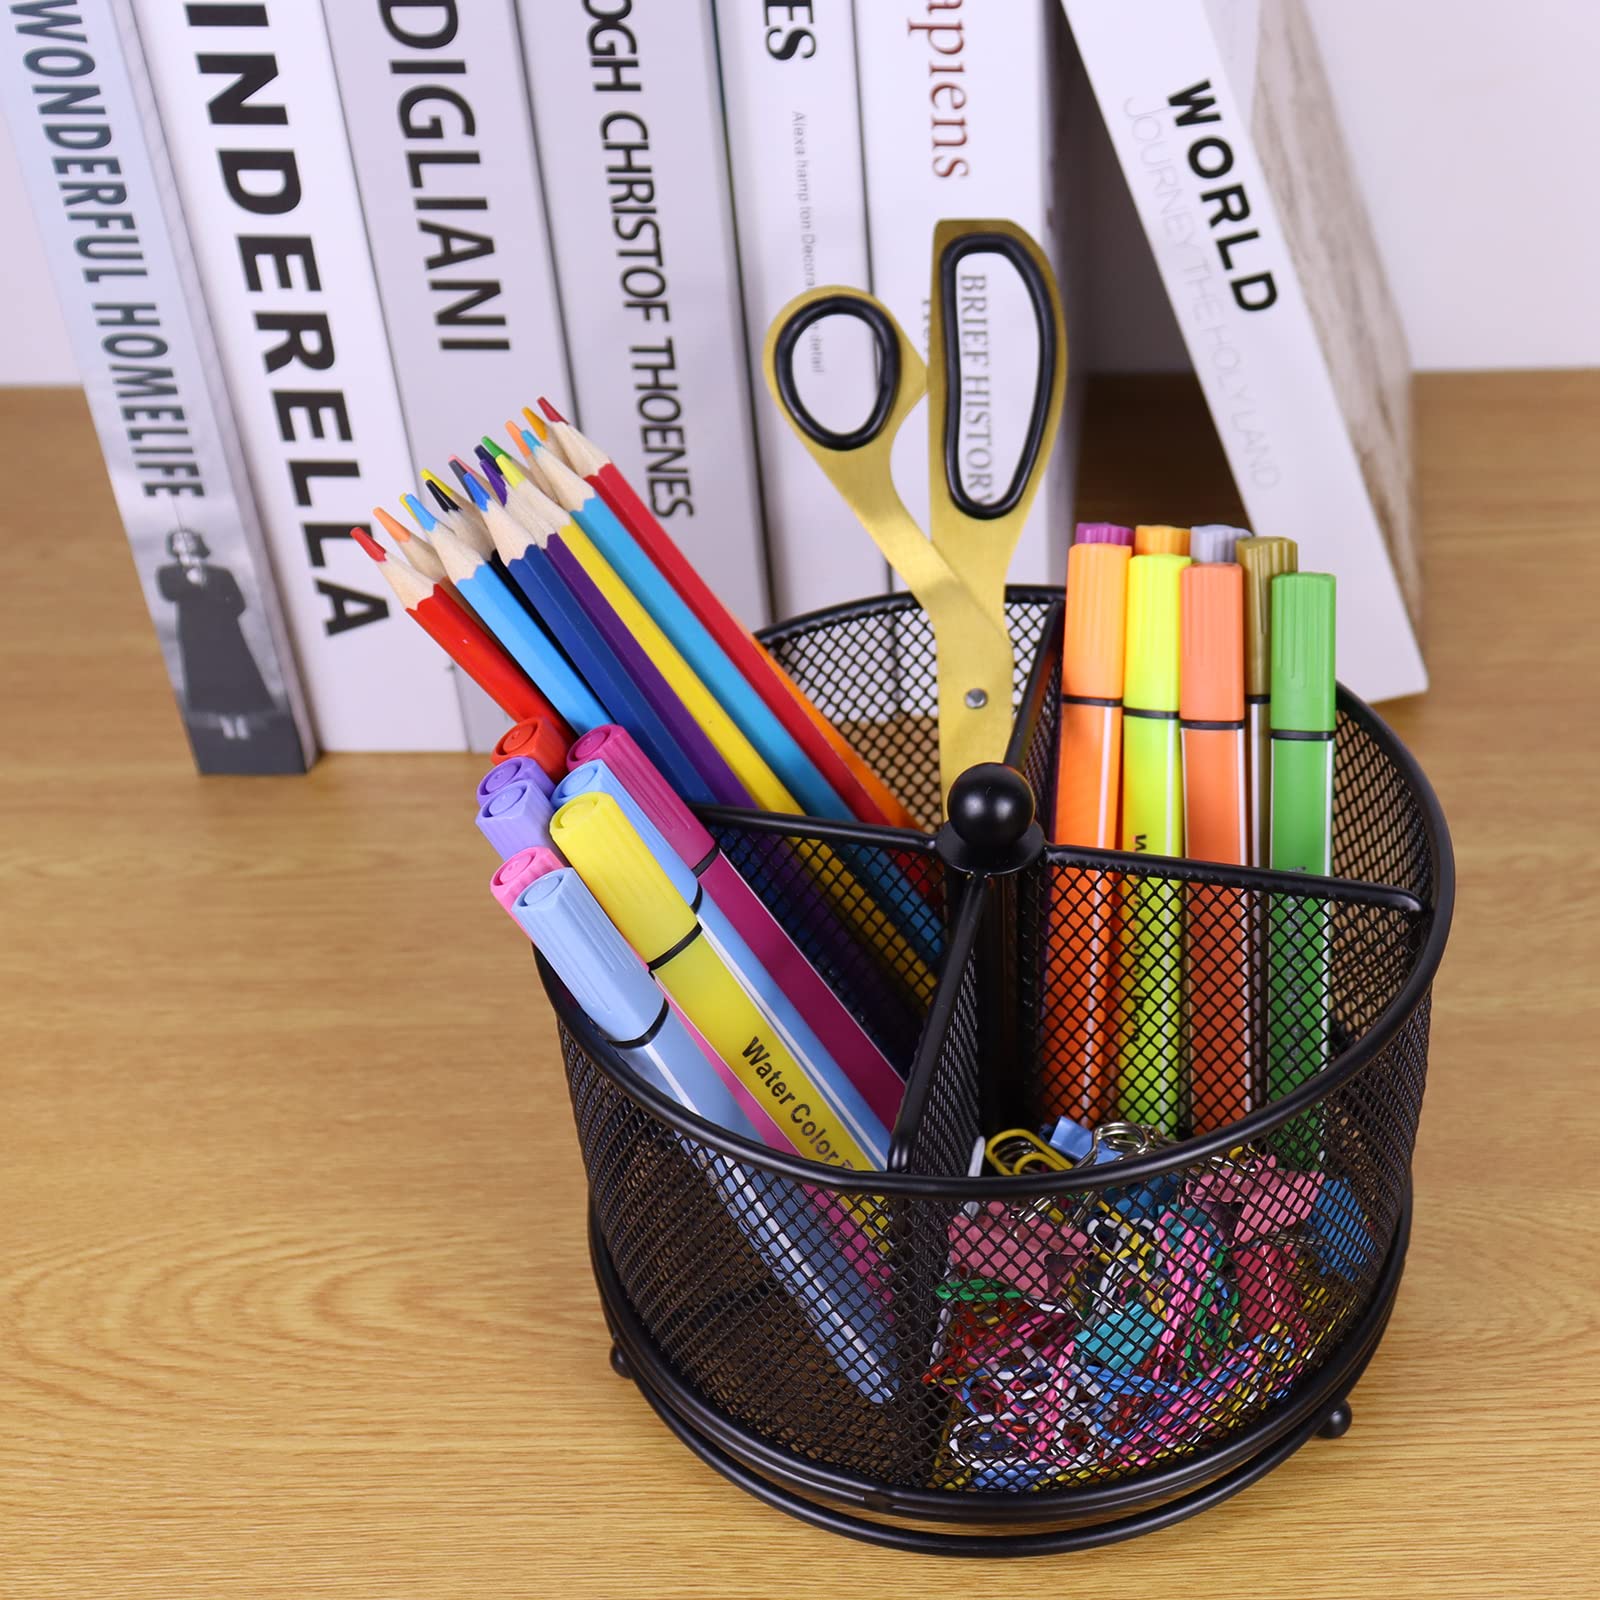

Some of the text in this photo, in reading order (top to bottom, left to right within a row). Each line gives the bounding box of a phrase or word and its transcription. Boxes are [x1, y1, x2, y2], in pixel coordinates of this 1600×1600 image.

[9, 0, 205, 497] WONDERFUL HOMELIFE
[377, 0, 510, 351] DIGLIANI
[599, 110, 671, 323] CHRISTOF
[1167, 78, 1278, 312] WORLD
[184, 3, 390, 637] INDERELLA
[960, 275, 989, 367] BRIEF
[1122, 96, 1199, 250] JOURNEY
[1183, 258, 1225, 321] THE
[1230, 404, 1282, 491] LAND
[630, 336, 694, 519] THOENES
[742, 1036, 839, 1162] Water Color
